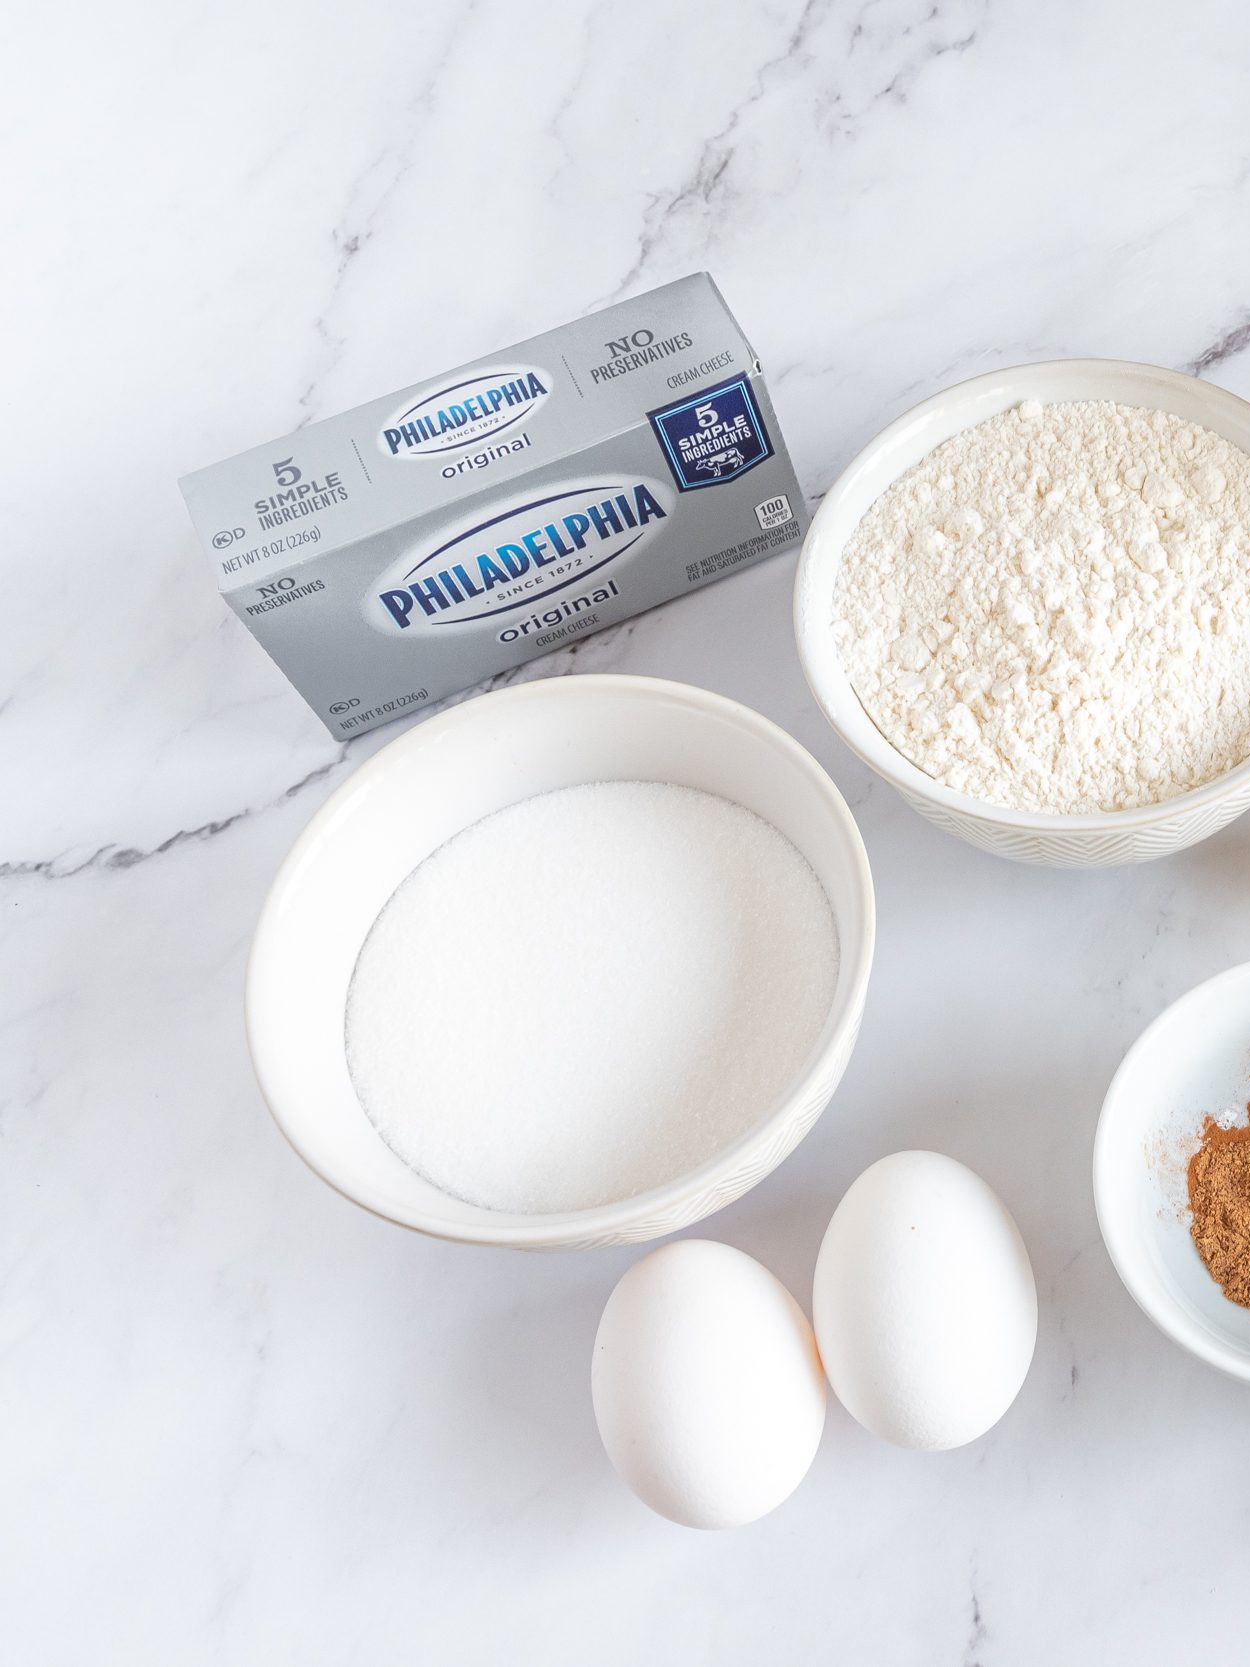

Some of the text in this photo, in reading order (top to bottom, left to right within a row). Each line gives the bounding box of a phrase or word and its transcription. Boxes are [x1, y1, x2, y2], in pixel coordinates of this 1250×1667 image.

[590, 332, 693, 384] PRESERVATIVES
[605, 329, 654, 359] NO
[667, 350, 735, 389] CREAM CHEESE
[383, 372, 548, 455] PHILADELPHIA
[446, 417, 500, 442] SINCE 1872
[678, 414, 747, 450] SIMPLE
[695, 402, 719, 428] 5
[442, 433, 532, 479] original
[682, 426, 752, 463] INGREDIENTS
[272, 456, 302, 486] 5
[254, 471, 342, 514] SIMPLE
[258, 486, 349, 531] INGREDIENTS
[759, 499, 784, 516] 100
[222, 525, 321, 575] NET WT 8 OZ (226g)
[379, 484, 667, 629] PHILADELPHIA
[700, 546, 737, 568] NUTRITION
[738, 528, 785, 552] INFORMATION
[246, 579, 326, 616] PRESERVATIVES
[256, 577, 296, 599] NO
[497, 558, 584, 602] SINCE 1872
[499, 580, 620, 643] original
[536, 613, 601, 647] CREAM CHEESE
[340, 688, 429, 730] NET WT 8 OZ (226g)
